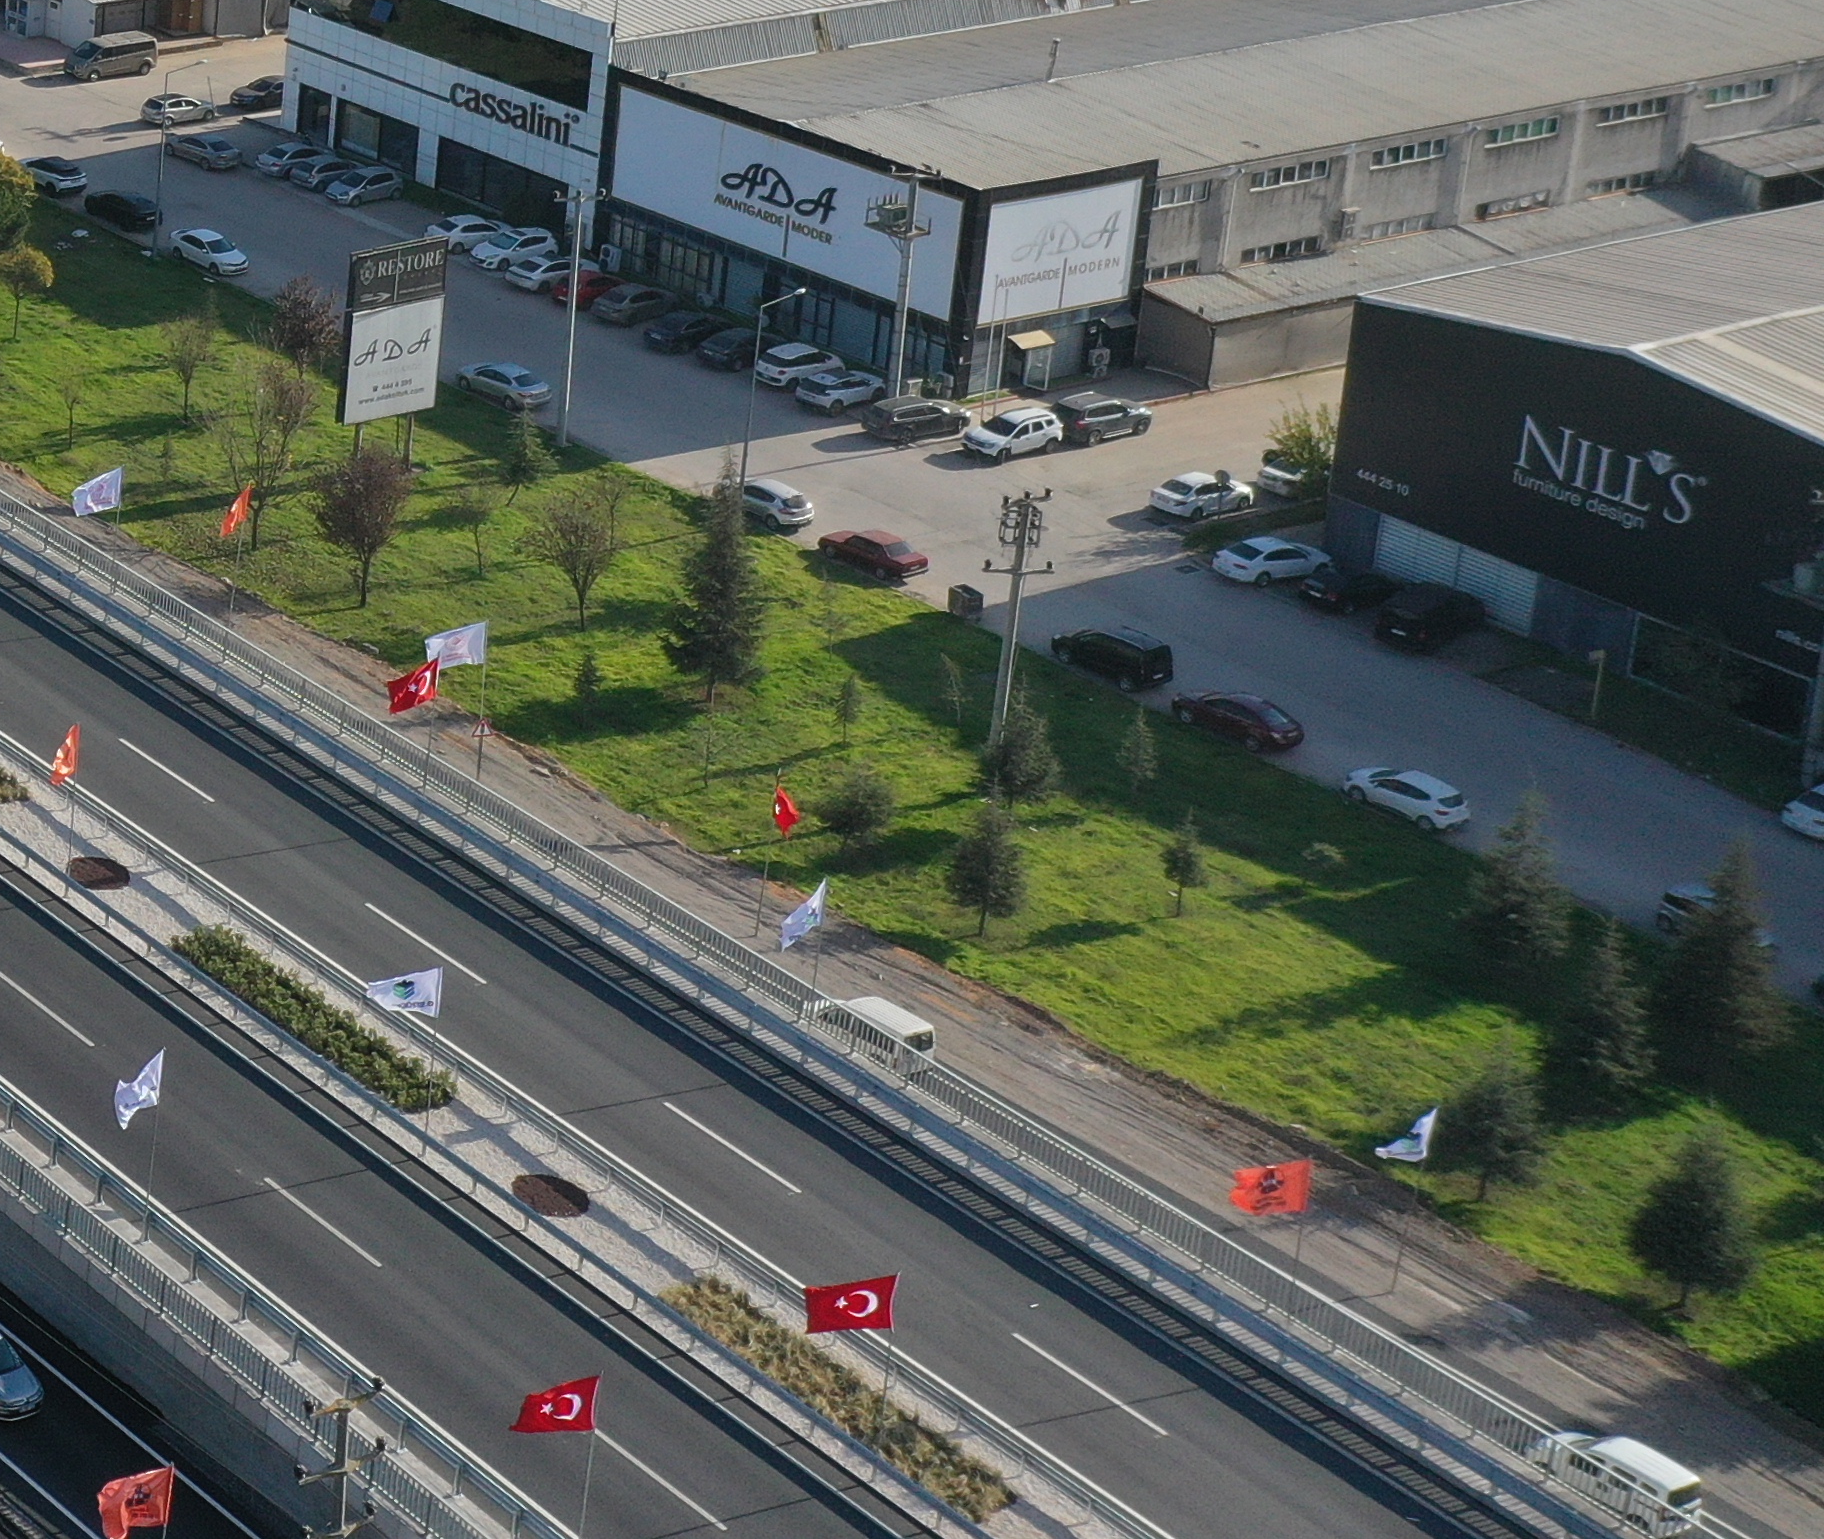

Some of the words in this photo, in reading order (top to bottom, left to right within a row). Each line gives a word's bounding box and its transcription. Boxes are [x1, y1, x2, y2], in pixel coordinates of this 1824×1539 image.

[449, 82, 571, 148] cassalini
[713, 192, 785, 228] AVANTGARDE
[720, 163, 838, 225] ADA
[1011, 209, 1122, 264] ADA
[376, 248, 445, 280] RESTORE
[997, 267, 1061, 290] AVANTGARDE
[1067, 256, 1121, 277] MODERN
[353, 327, 433, 368] ADA
[1511, 468, 1582, 508] furniture
[1584, 496, 1646, 531] design
